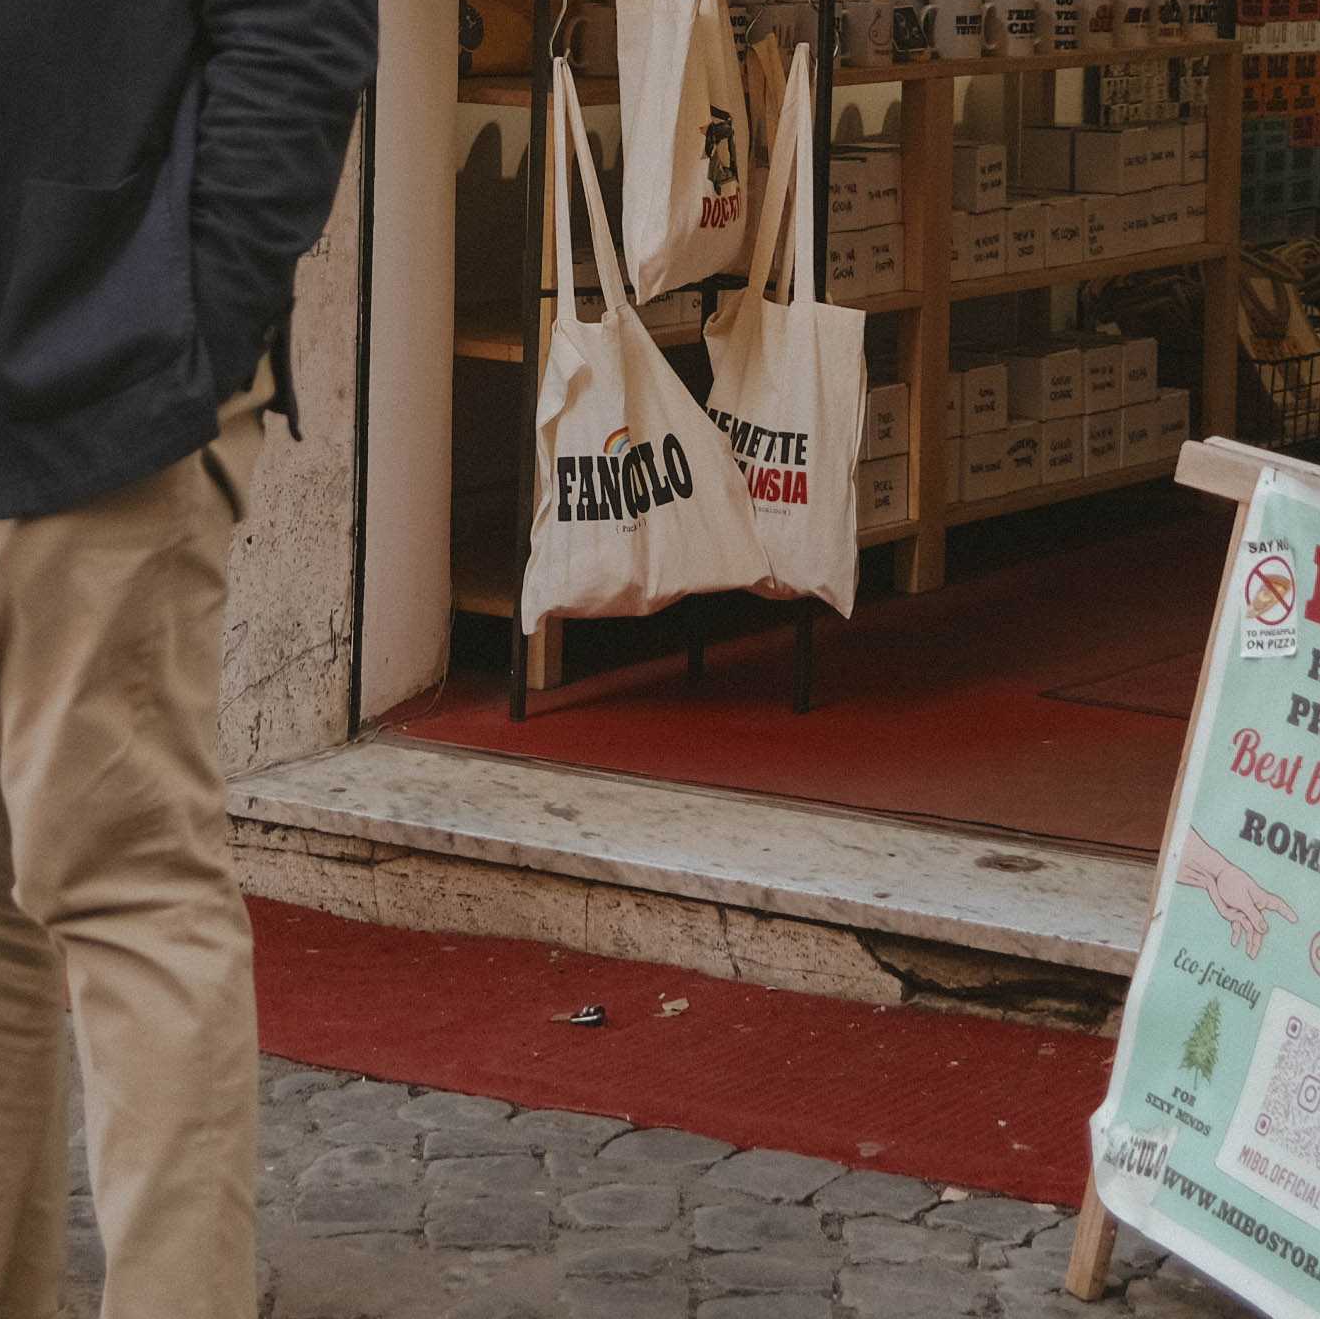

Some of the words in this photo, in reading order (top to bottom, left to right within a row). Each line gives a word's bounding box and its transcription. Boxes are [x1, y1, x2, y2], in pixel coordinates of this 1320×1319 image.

[1248, 540, 1273, 554] SAY
[1246, 629, 1257, 638] TO
[1246, 640, 1264, 650] ON
[1230, 727, 1304, 795] Best
[1173, 947, 1262, 1011] Eco-friendly
[1145, 1092, 1175, 1116] SEXY
[1171, 1086, 1197, 1108] FOR
